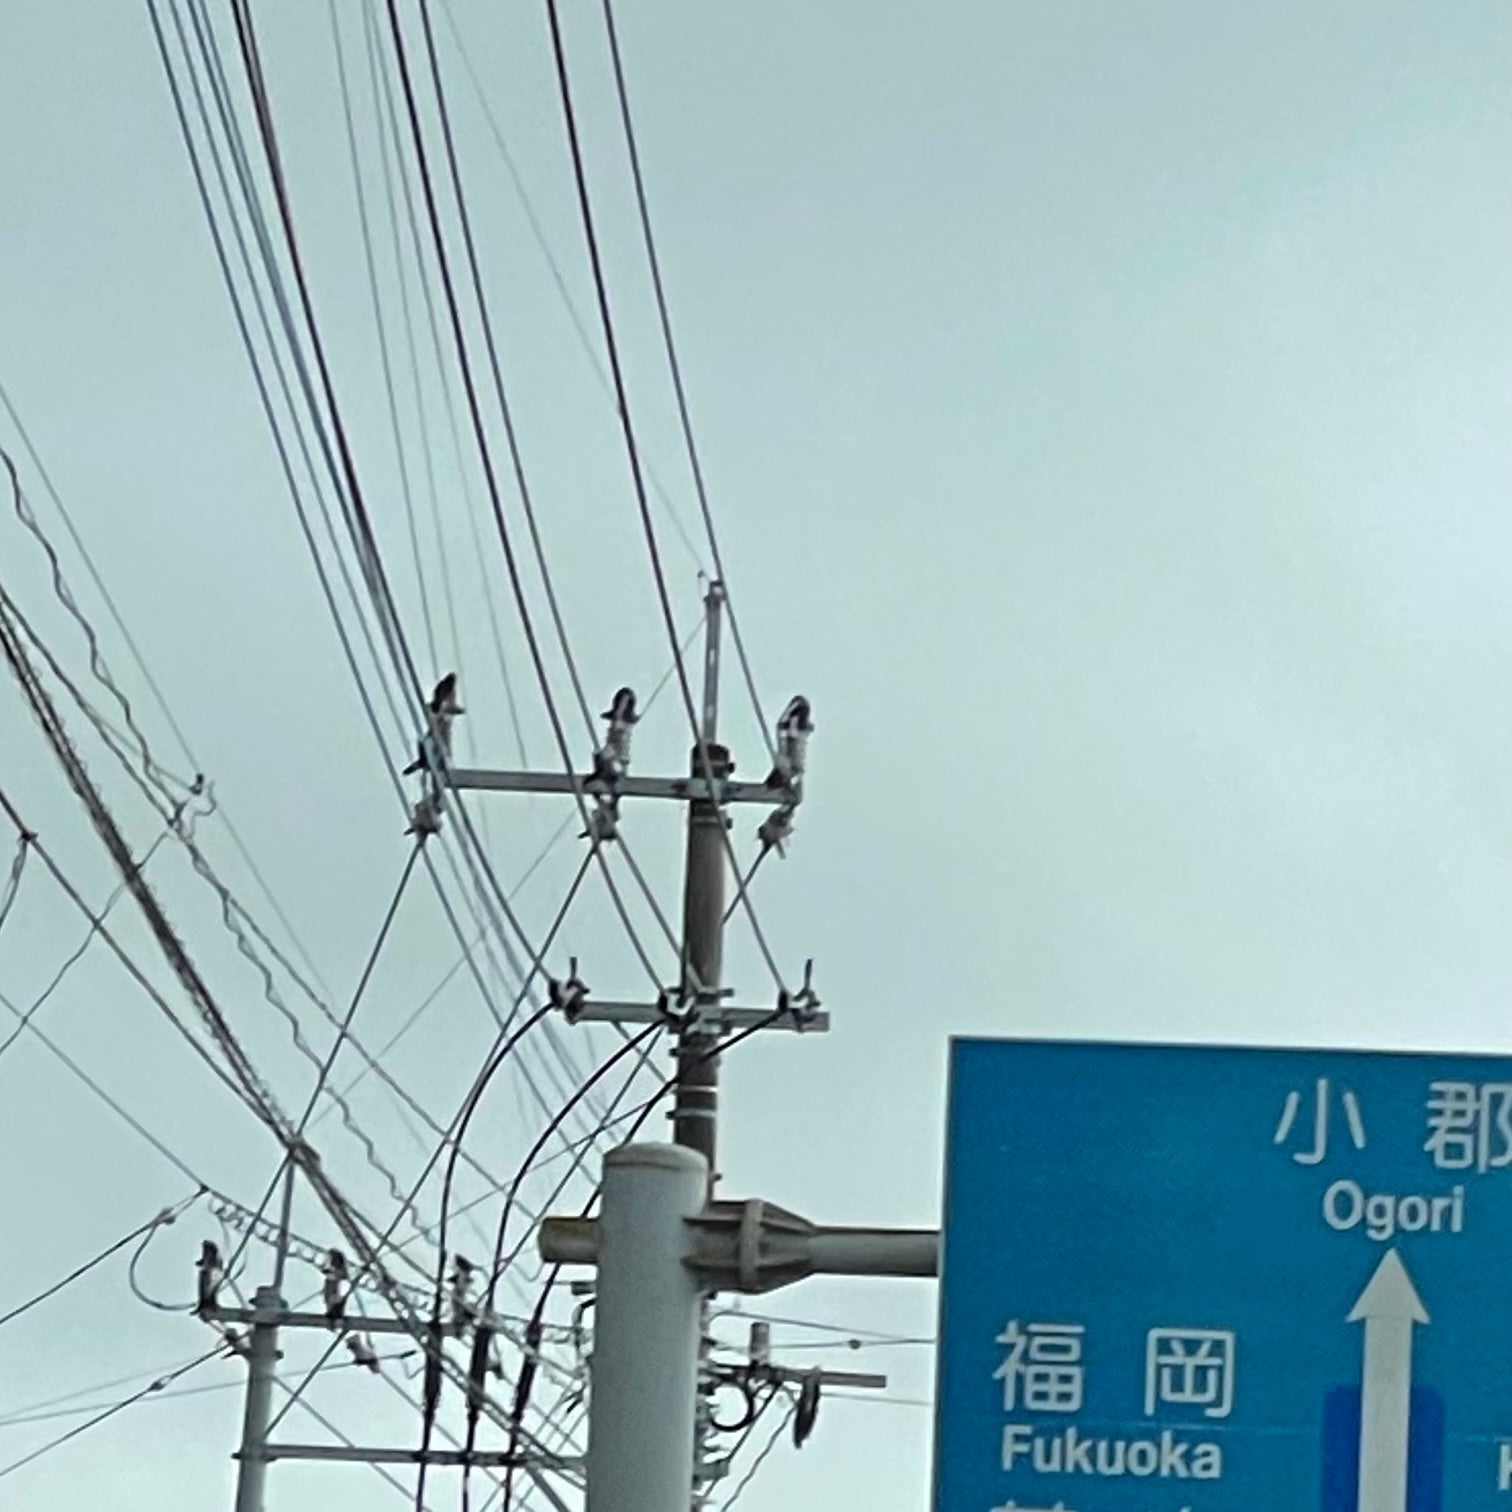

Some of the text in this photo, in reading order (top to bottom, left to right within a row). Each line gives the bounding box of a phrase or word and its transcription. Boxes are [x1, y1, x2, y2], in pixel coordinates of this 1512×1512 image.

[1274, 1078, 1512, 1174] 小郡
[1323, 1179, 1465, 1241] Ogori
[992, 1318, 1235, 1418] 福岡
[1001, 1424, 1222, 1479] Fukuoka
